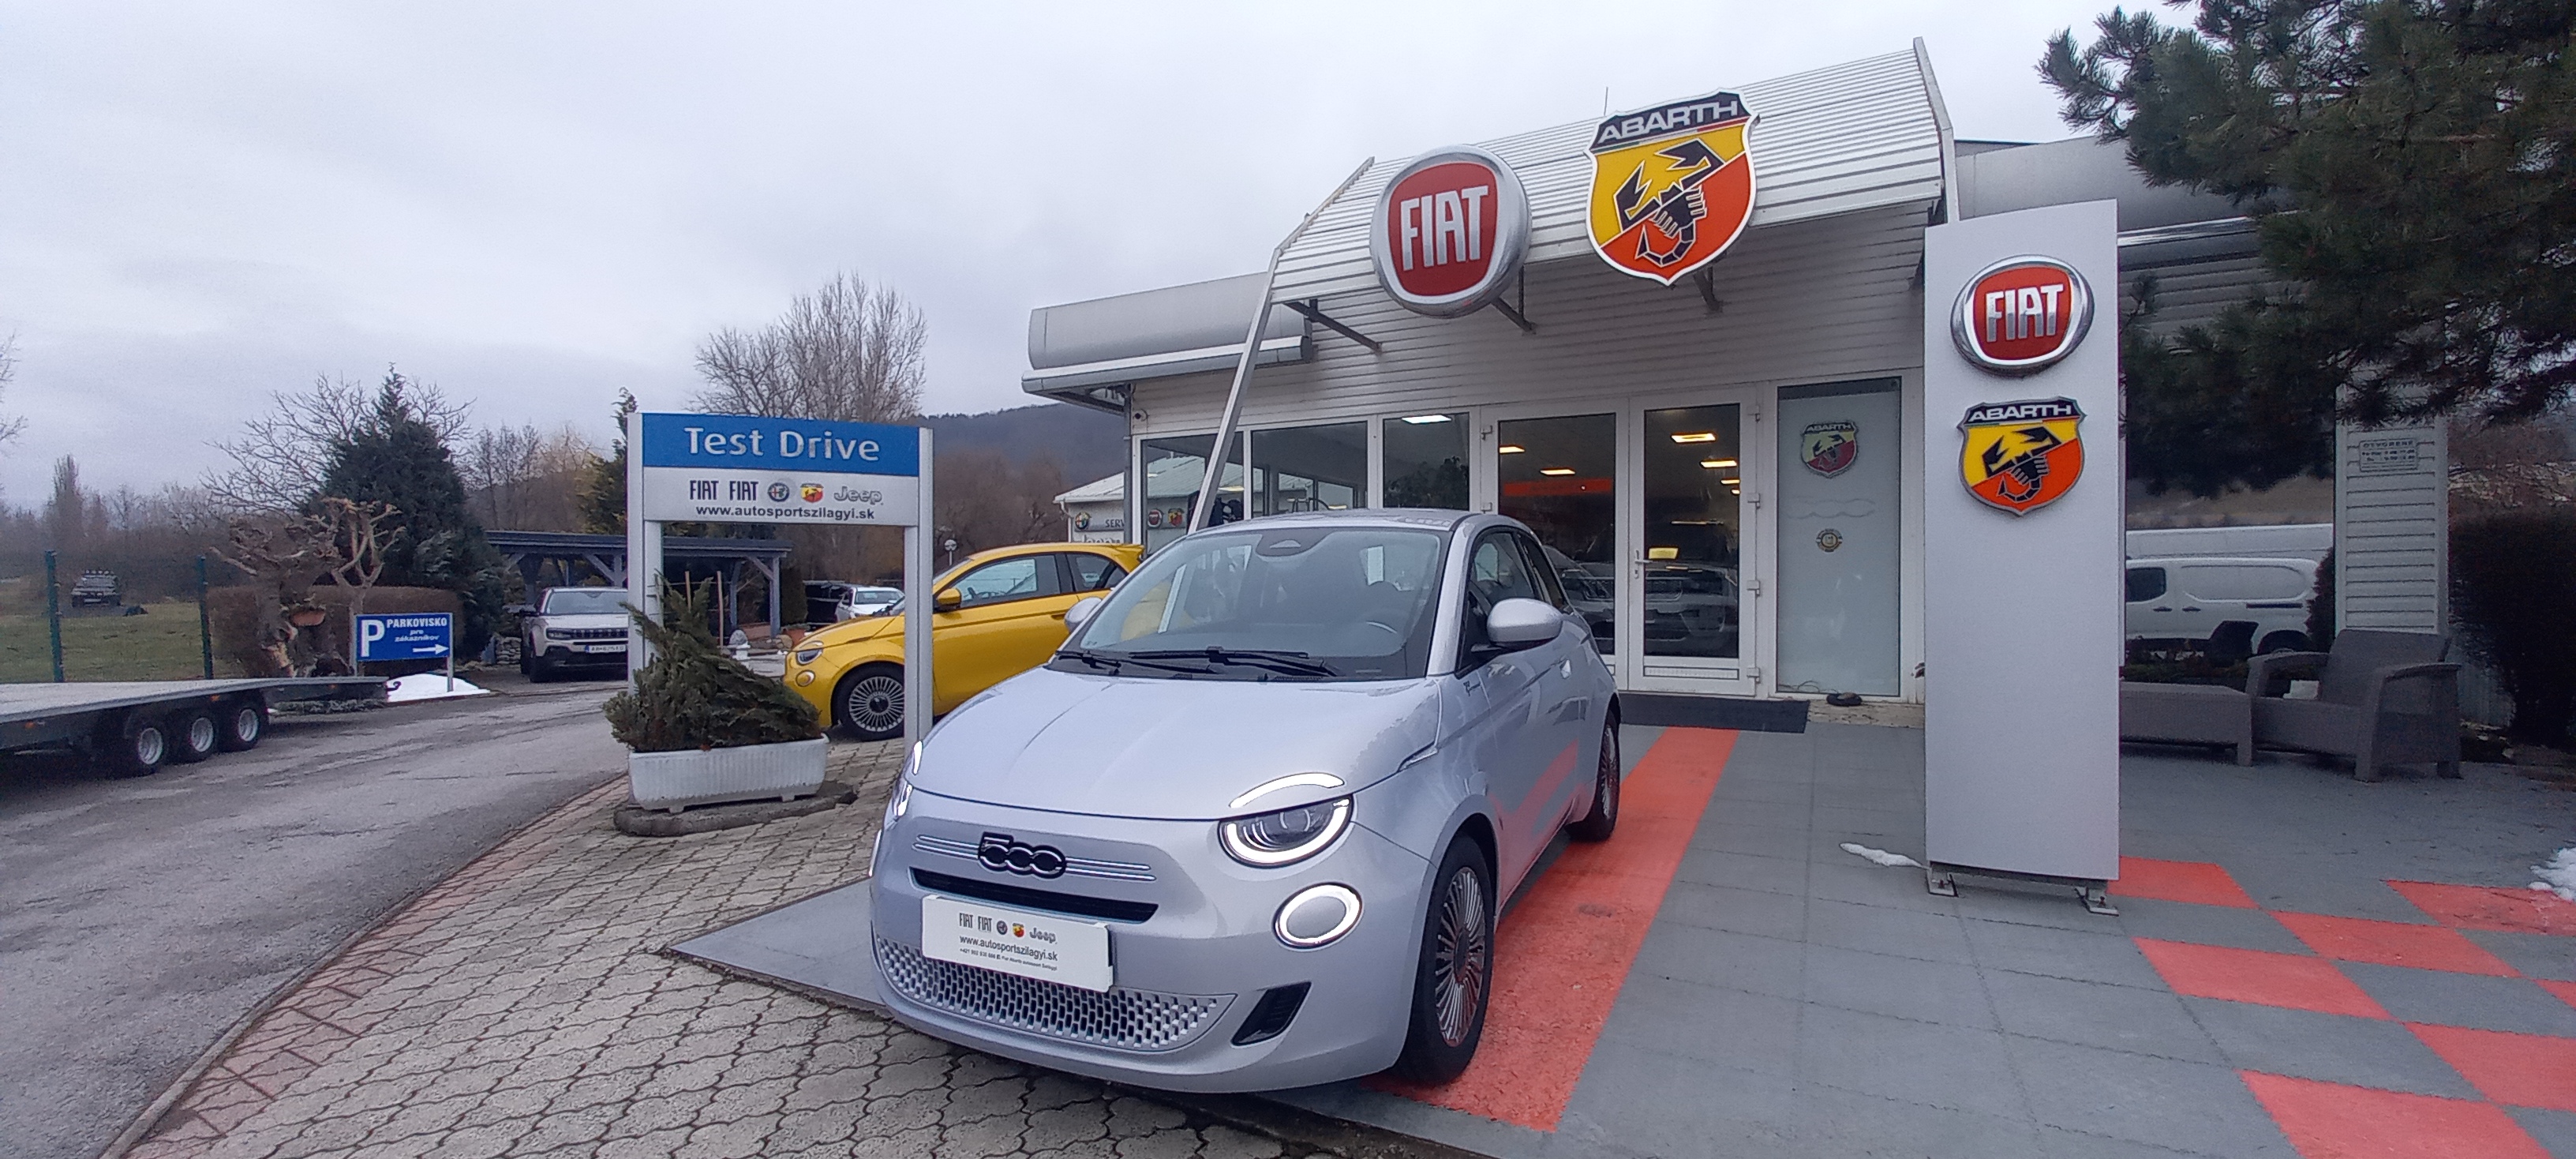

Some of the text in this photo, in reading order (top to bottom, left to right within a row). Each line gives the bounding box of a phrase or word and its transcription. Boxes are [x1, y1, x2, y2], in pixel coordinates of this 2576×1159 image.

[1597, 101, 1737, 144] ABARTH
[1399, 185, 1489, 272] FIAT
[1985, 283, 2065, 343] FIAT
[1968, 404, 2072, 422] ABARTH
[1807, 423, 1852, 432] ABARTH
[683, 426, 881, 461] Test Drive
[689, 480, 883, 505] FIAT FIAT Jeep
[695, 504, 875, 521] www.autosportszilagyi.sk
[386, 617, 447, 628] PARKOVISKO
[361, 619, 385, 657] P
[978, 831, 1067, 879] 500
[959, 912, 974, 929] FIAT
[978, 915, 993, 932] FIAT
[959, 935, 1058, 962] www.autosportszilagyi.sk
